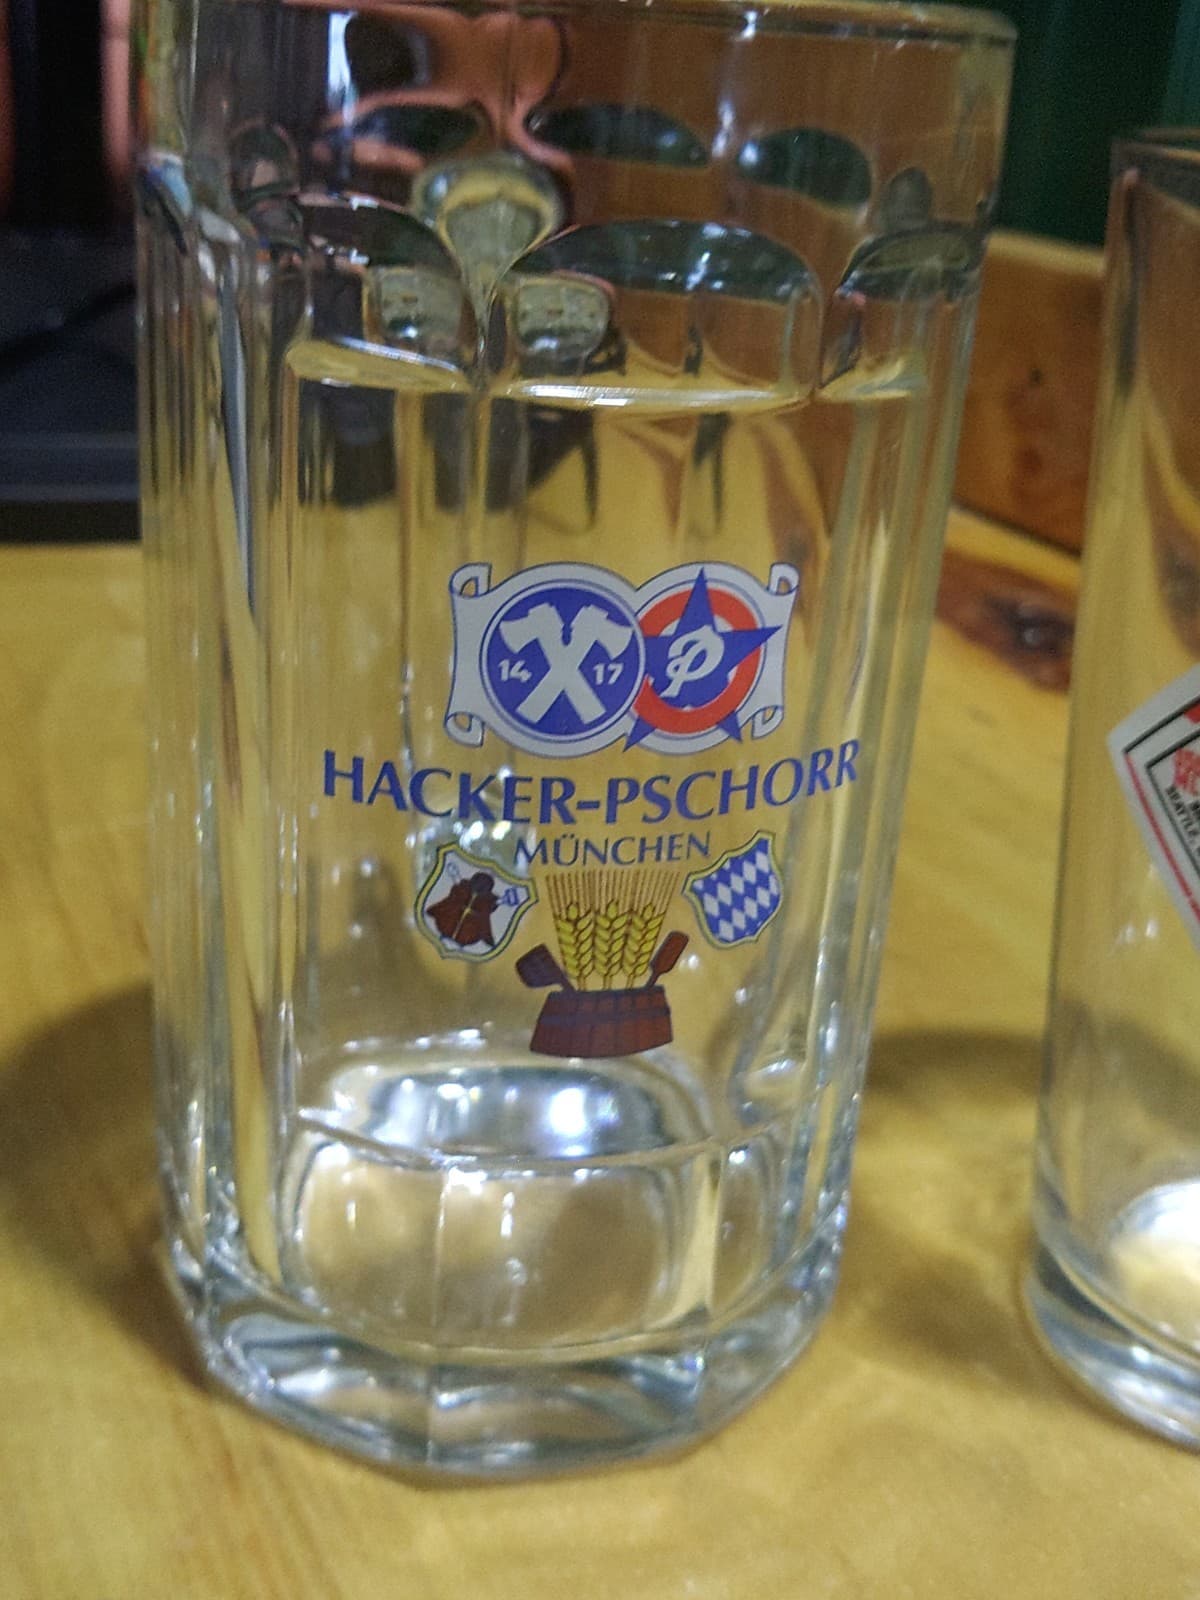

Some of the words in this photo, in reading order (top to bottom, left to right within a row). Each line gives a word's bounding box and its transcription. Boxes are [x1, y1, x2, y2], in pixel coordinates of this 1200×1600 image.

[498, 659, 533, 684] 14
[592, 663, 624, 686] 17
[323, 739, 860, 825] HACKER-PSCHORR
[513, 831, 712, 867] MÜNCHEN
